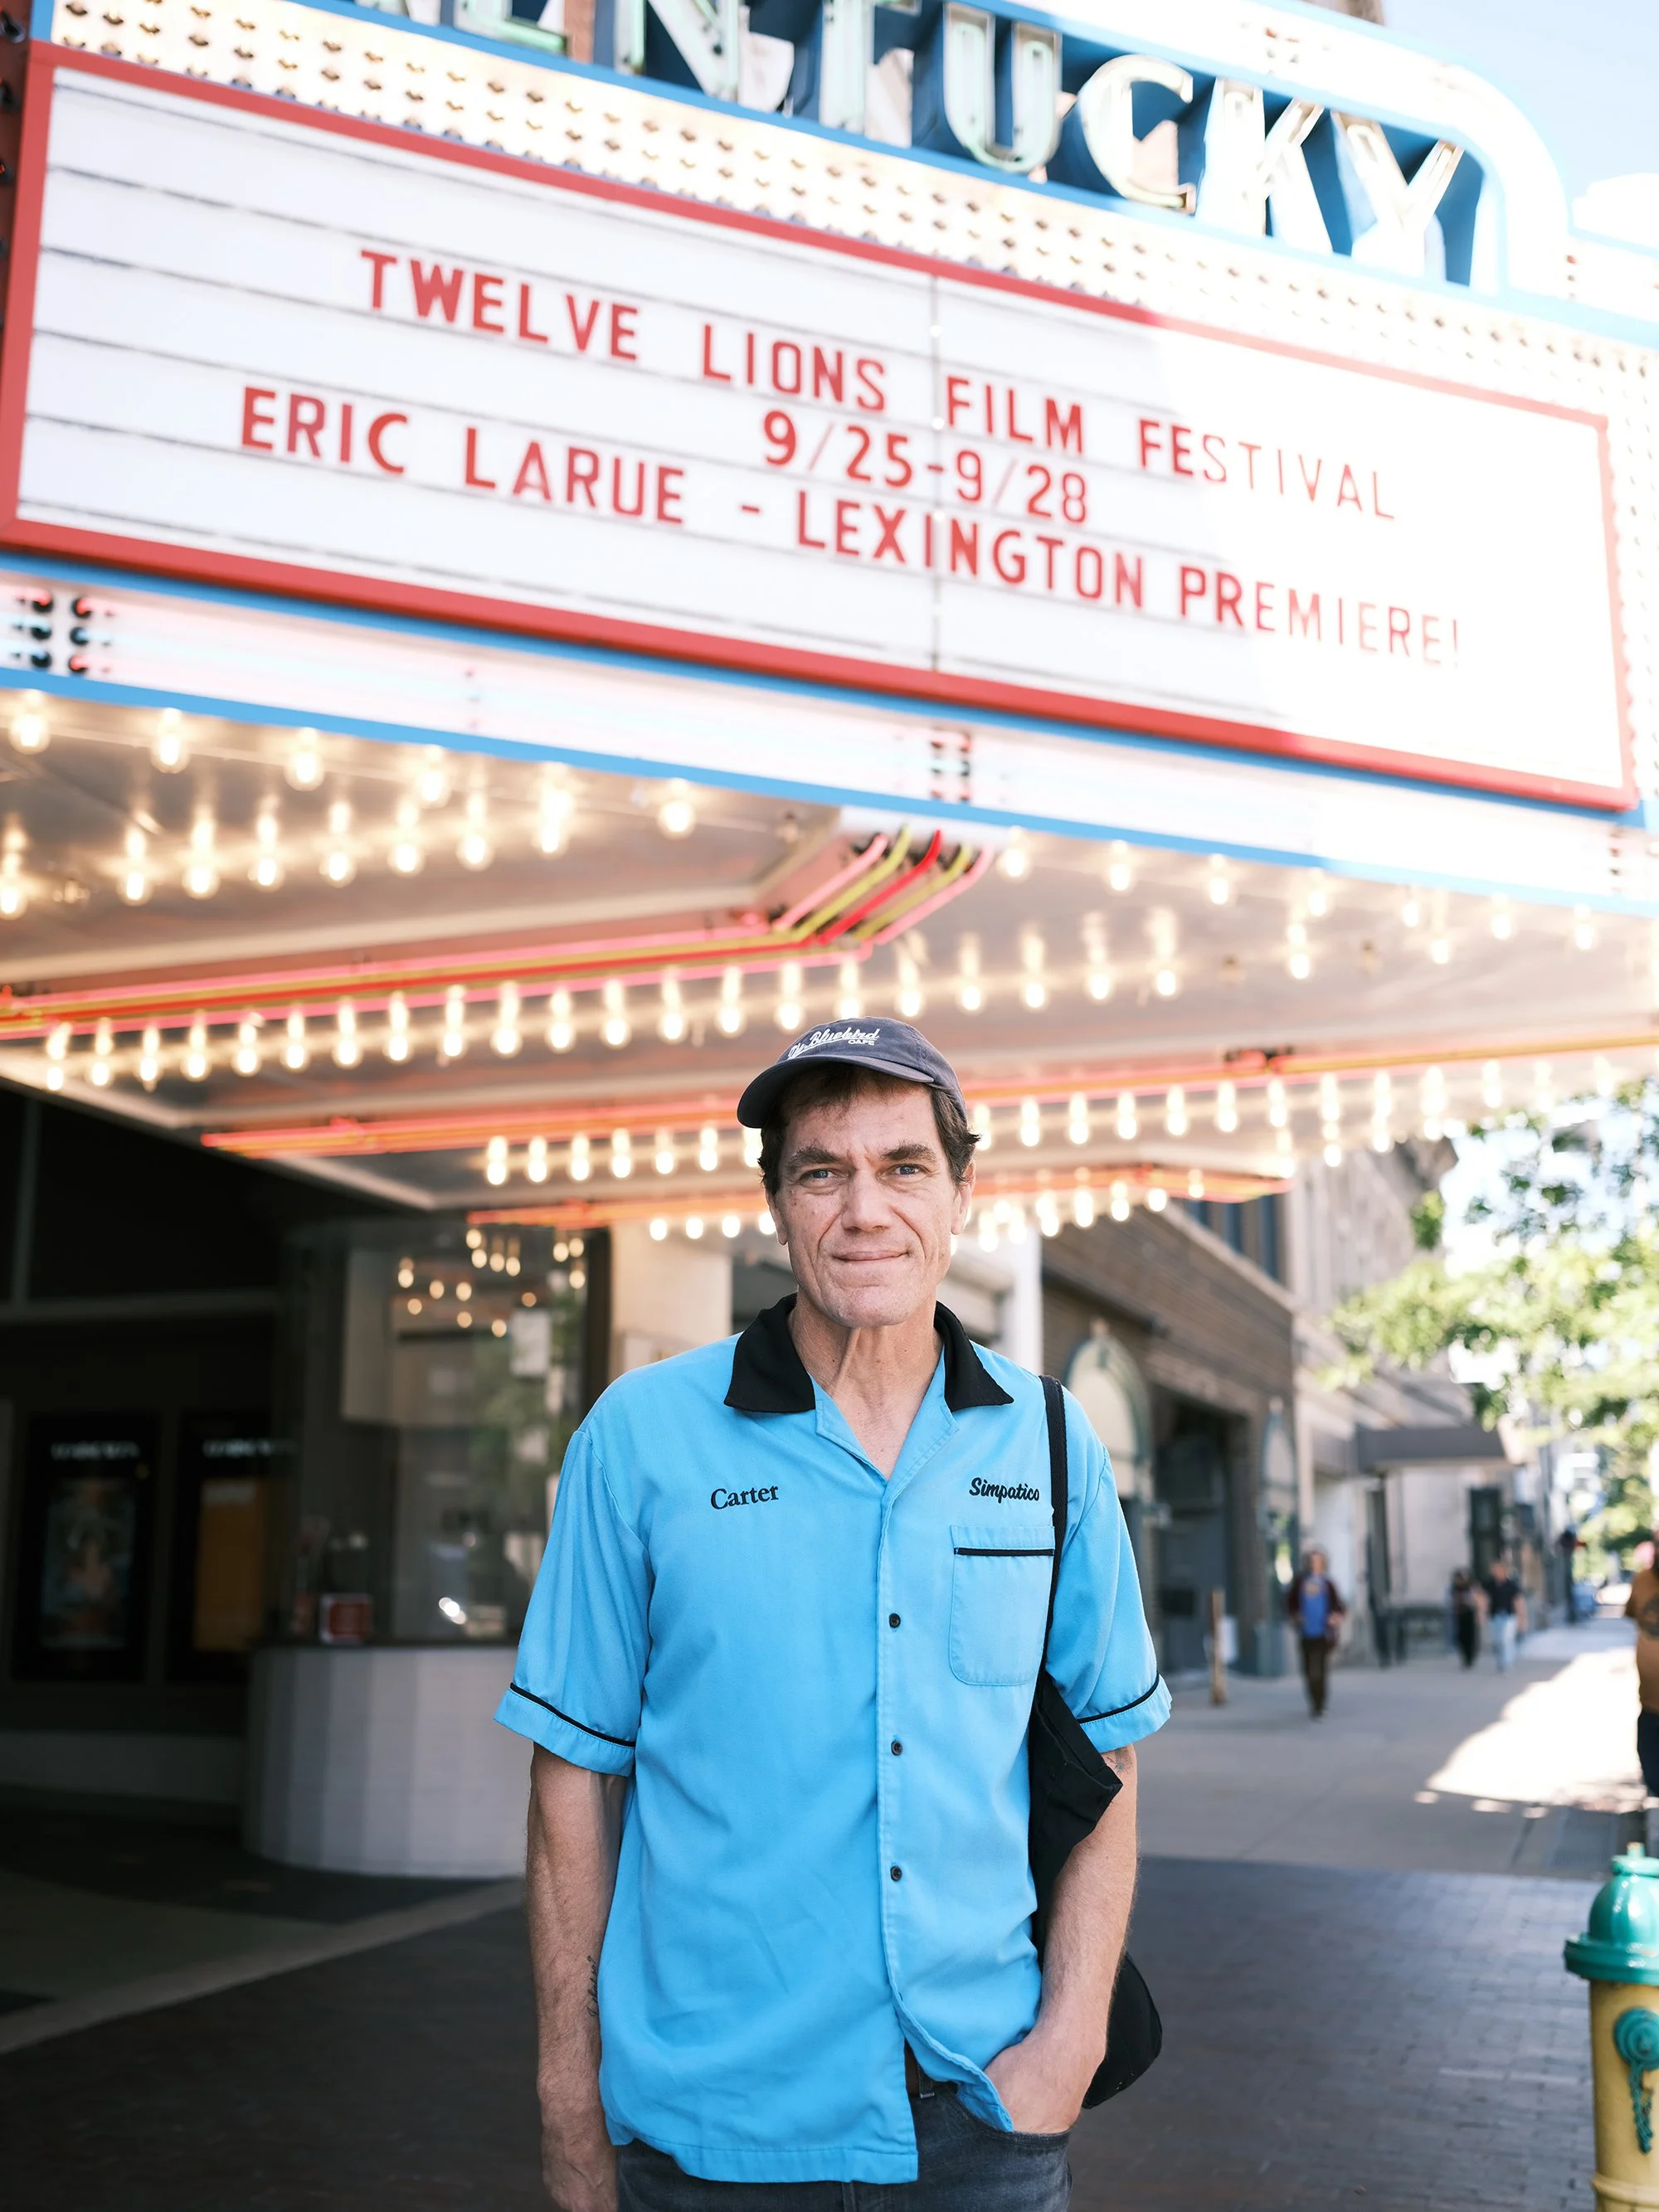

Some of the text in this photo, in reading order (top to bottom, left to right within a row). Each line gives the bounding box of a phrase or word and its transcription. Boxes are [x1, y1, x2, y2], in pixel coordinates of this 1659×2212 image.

[355, 0, 1465, 274] NTUCKY
[360, 249, 1395, 521] TWELVE LIONS FILM FESTIVAL
[762, 410, 1087, 525] 9/25-9/28
[241, 386, 408, 474] ERIC
[465, 425, 685, 525] LARUE
[798, 490, 1144, 610] LEXINGTON
[1180, 564, 1459, 668] PREMIERE!
[710, 1482, 780, 1510] Carter
[968, 1476, 1041, 1504] Simpatico
